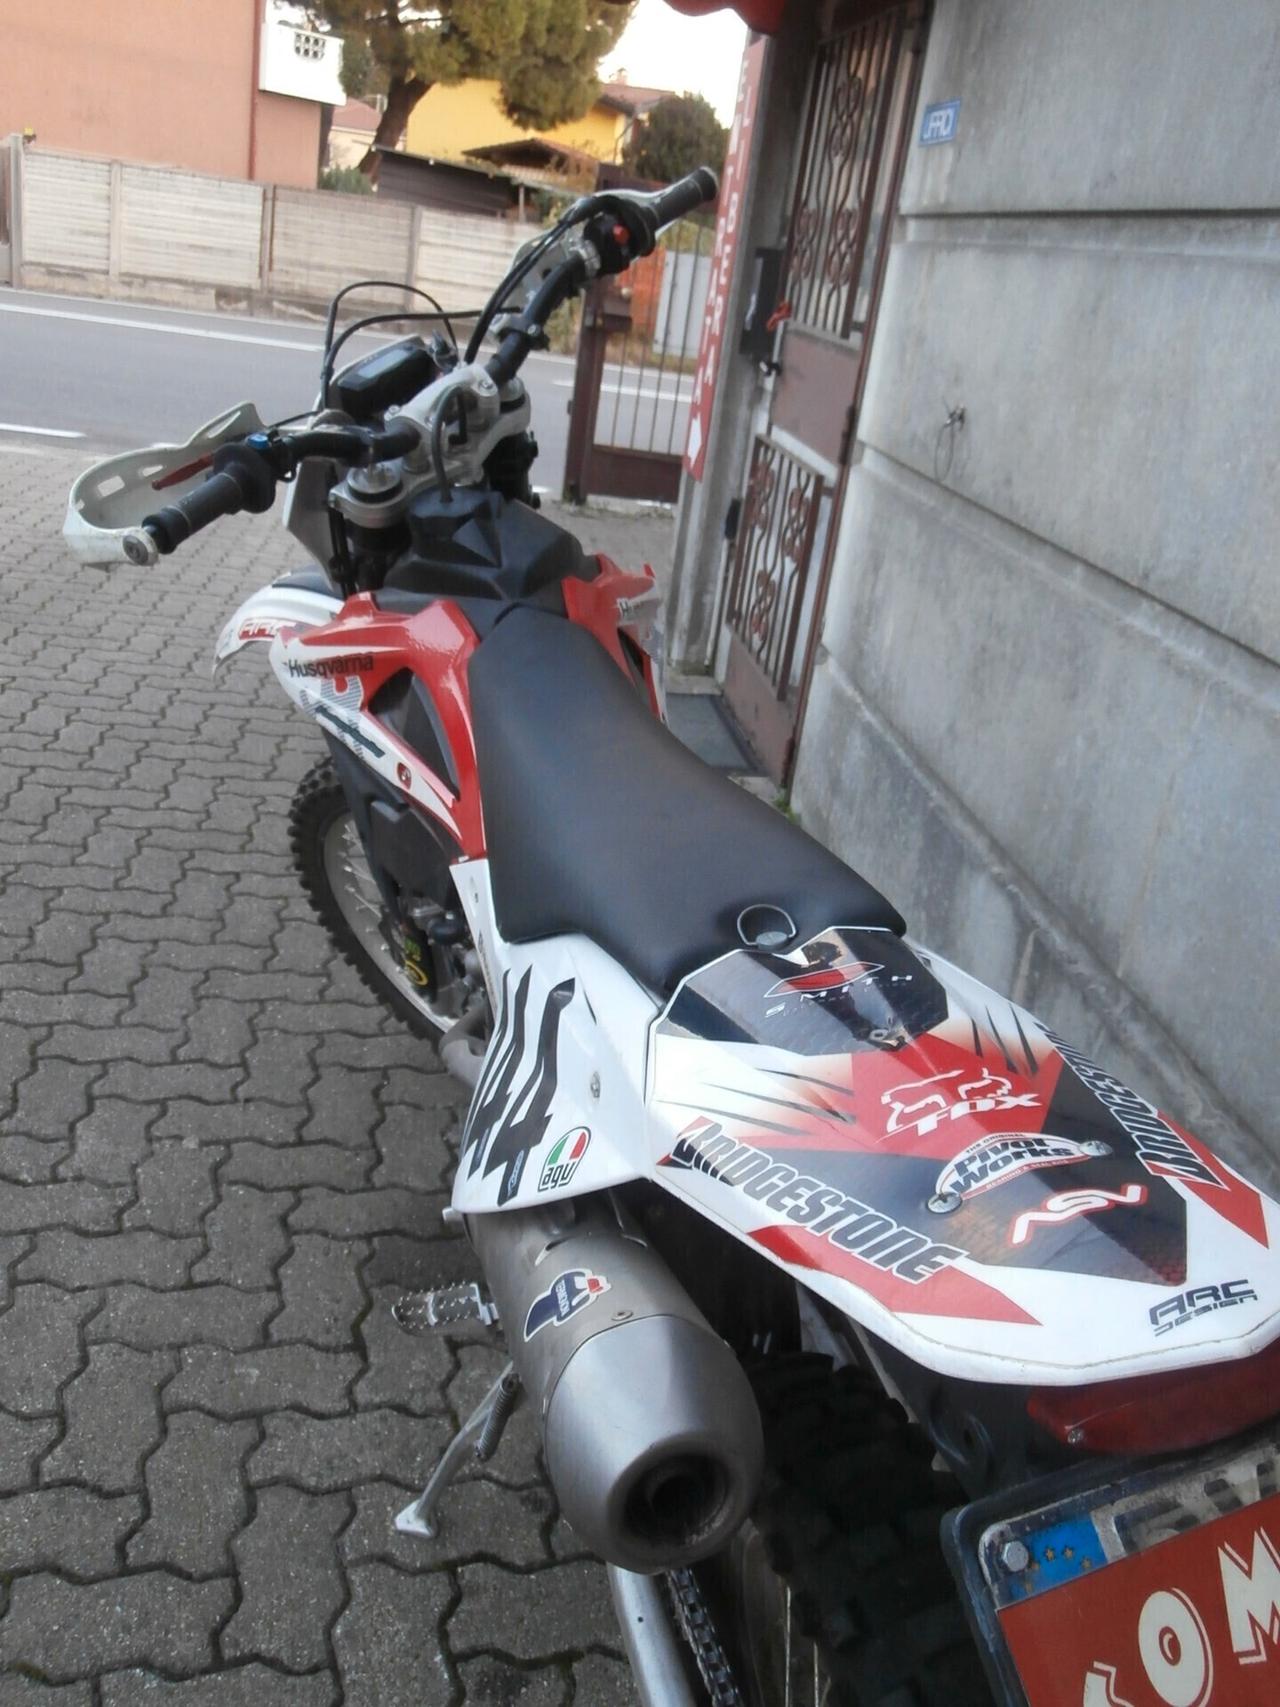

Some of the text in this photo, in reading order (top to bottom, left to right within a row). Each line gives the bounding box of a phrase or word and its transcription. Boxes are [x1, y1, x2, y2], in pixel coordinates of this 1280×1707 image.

[693, 58, 749, 405] ENTRATA
[704, 85, 753, 386] LIBERA
[287, 654, 374, 679] Husqvarna
[888, 1093, 1042, 1139] FOX
[541, 1160, 577, 1189] agv
[660, 1117, 969, 1284] BRIDGESTONE
[1148, 1279, 1255, 1326] ARC
[1153, 1294, 1259, 1337] DESIGN
